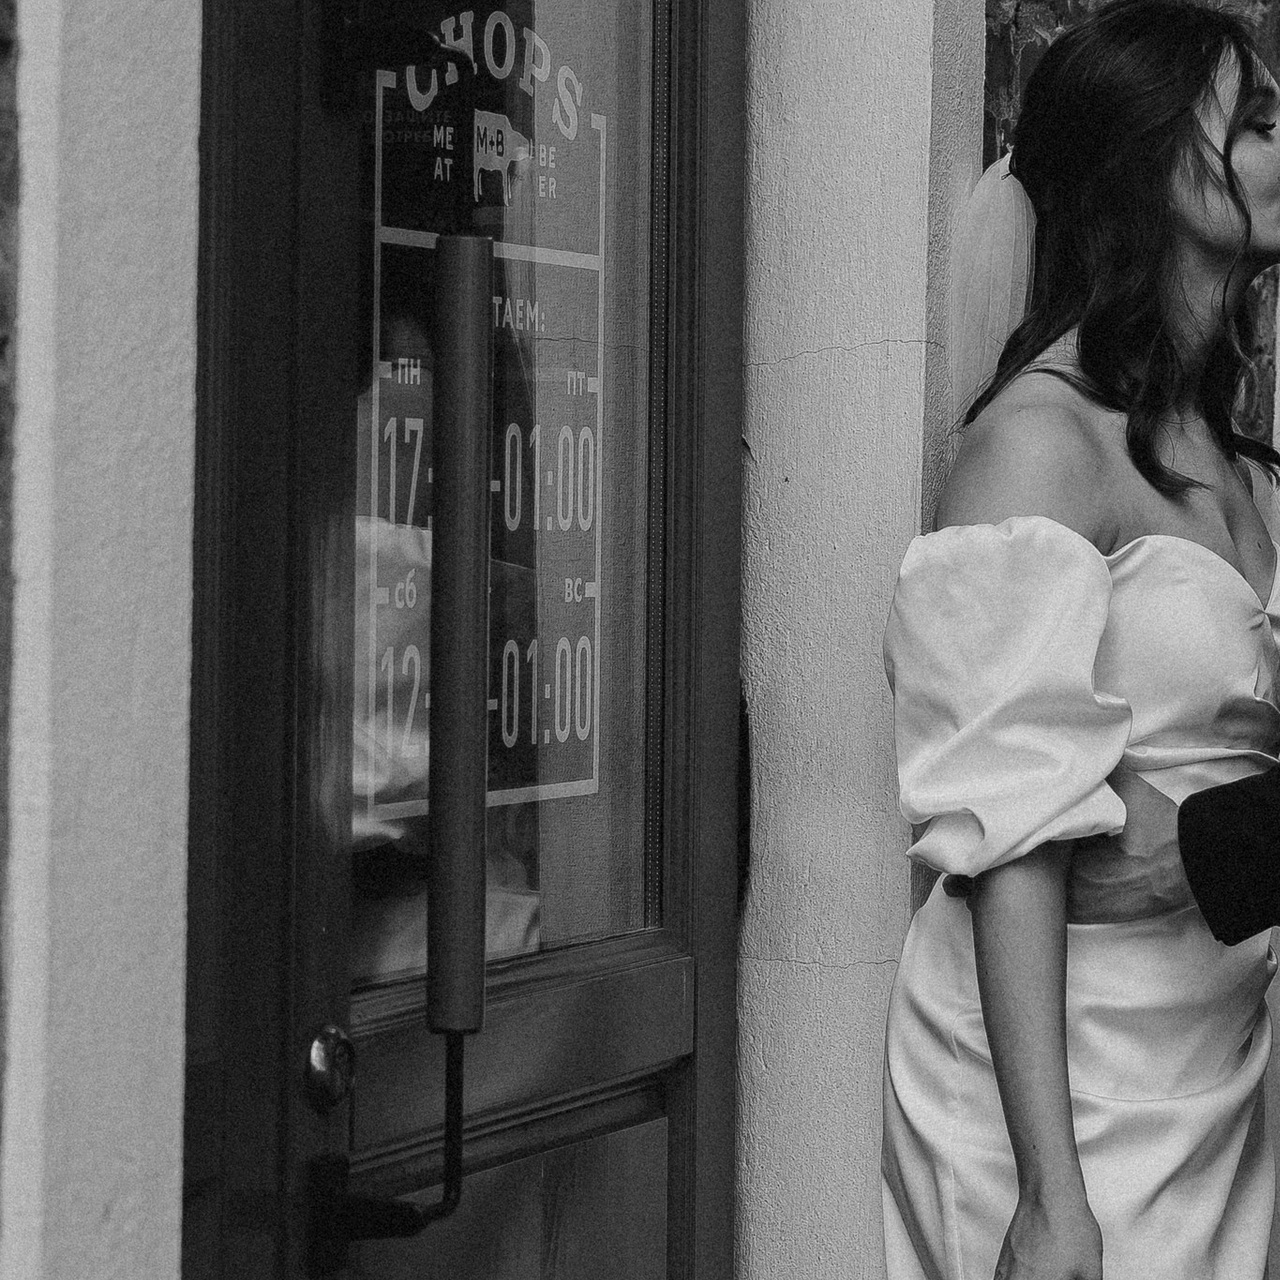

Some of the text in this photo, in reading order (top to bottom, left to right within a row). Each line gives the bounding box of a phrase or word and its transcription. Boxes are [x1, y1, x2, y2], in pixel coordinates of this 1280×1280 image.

[433, 124, 454, 150] ME
[539, 144, 557, 168] BE
[433, 157, 453, 182] AT
[538, 175, 557, 199] ER
[398, 357, 586, 395] ПН ПТ
